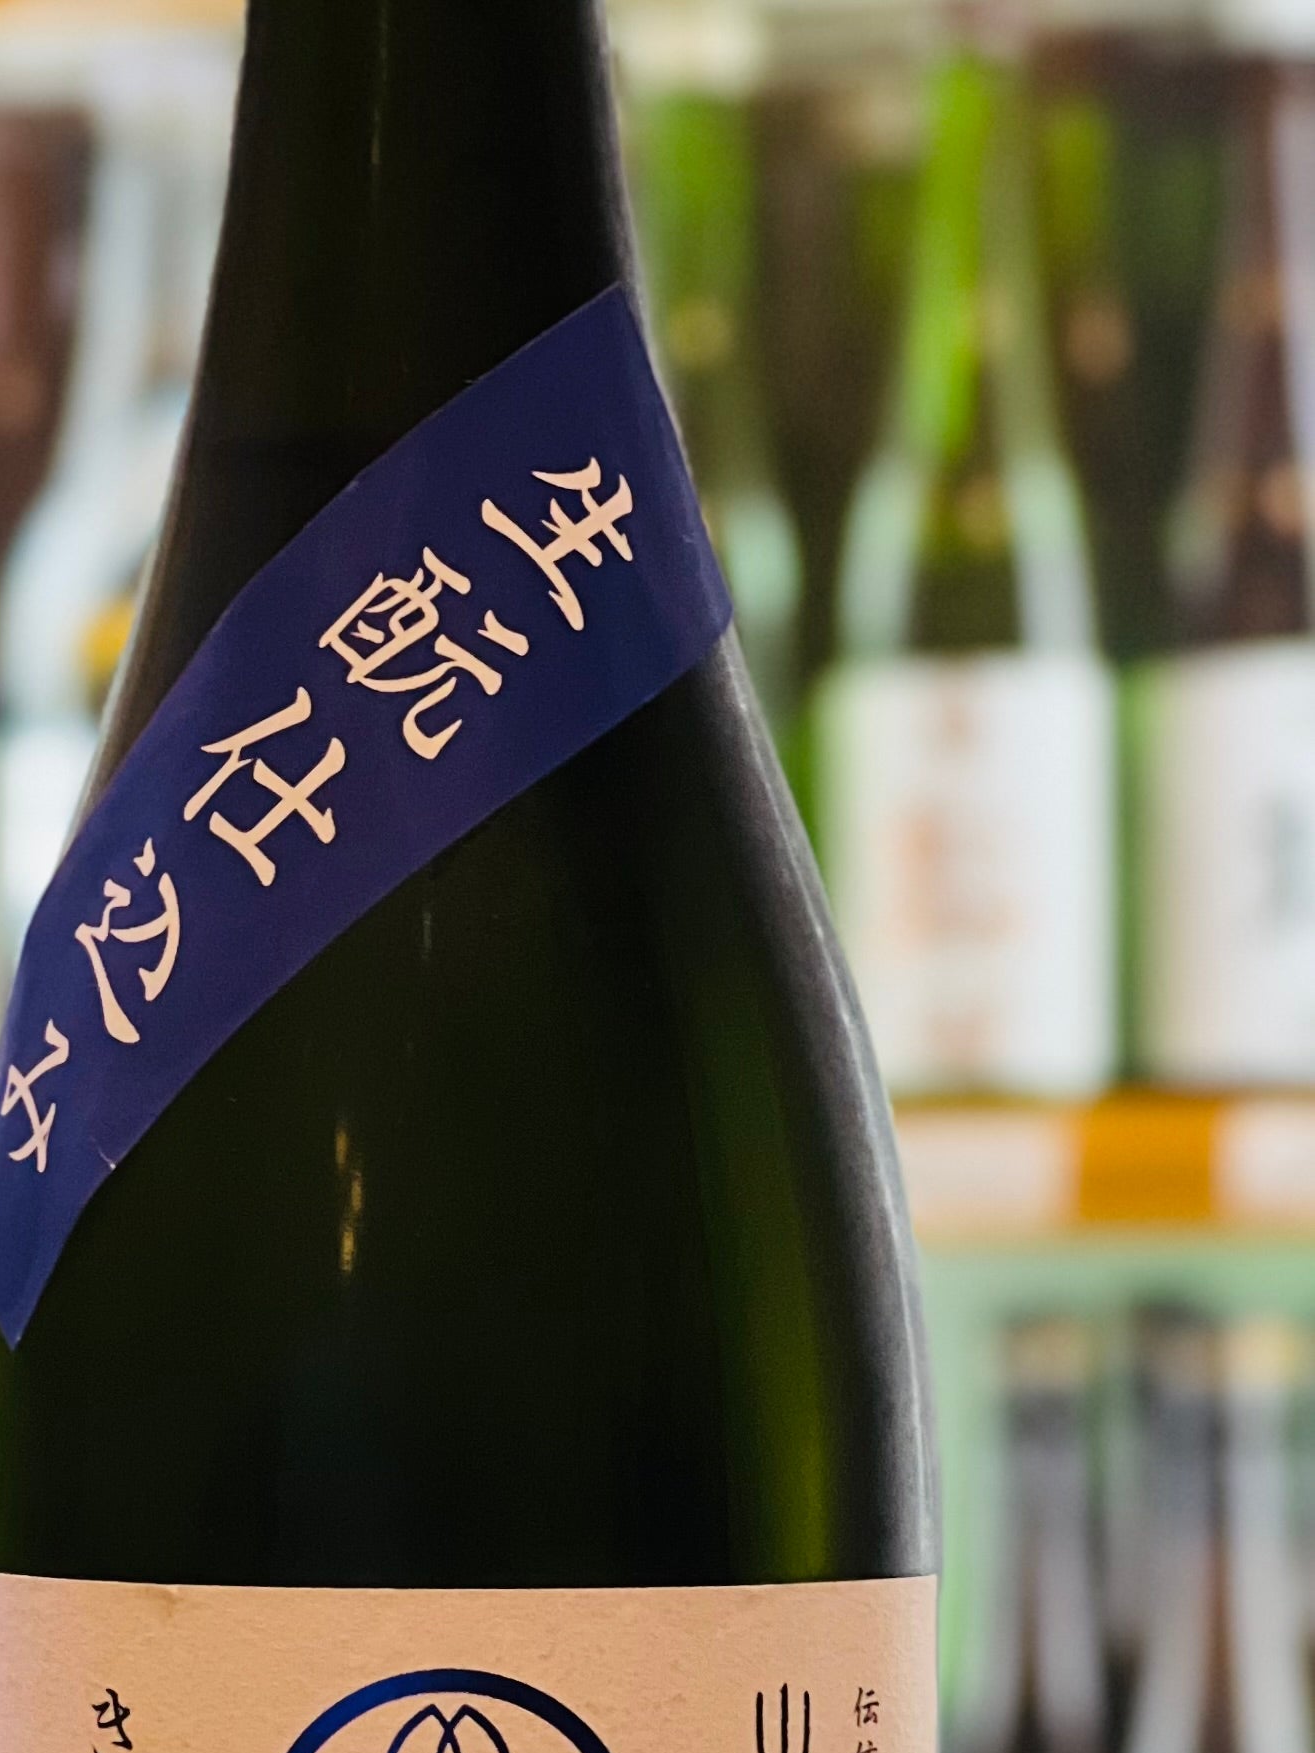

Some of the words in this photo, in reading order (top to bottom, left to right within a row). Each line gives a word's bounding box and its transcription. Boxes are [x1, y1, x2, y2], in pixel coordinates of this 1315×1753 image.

[0, 455, 634, 1173] 生酛仕込み
